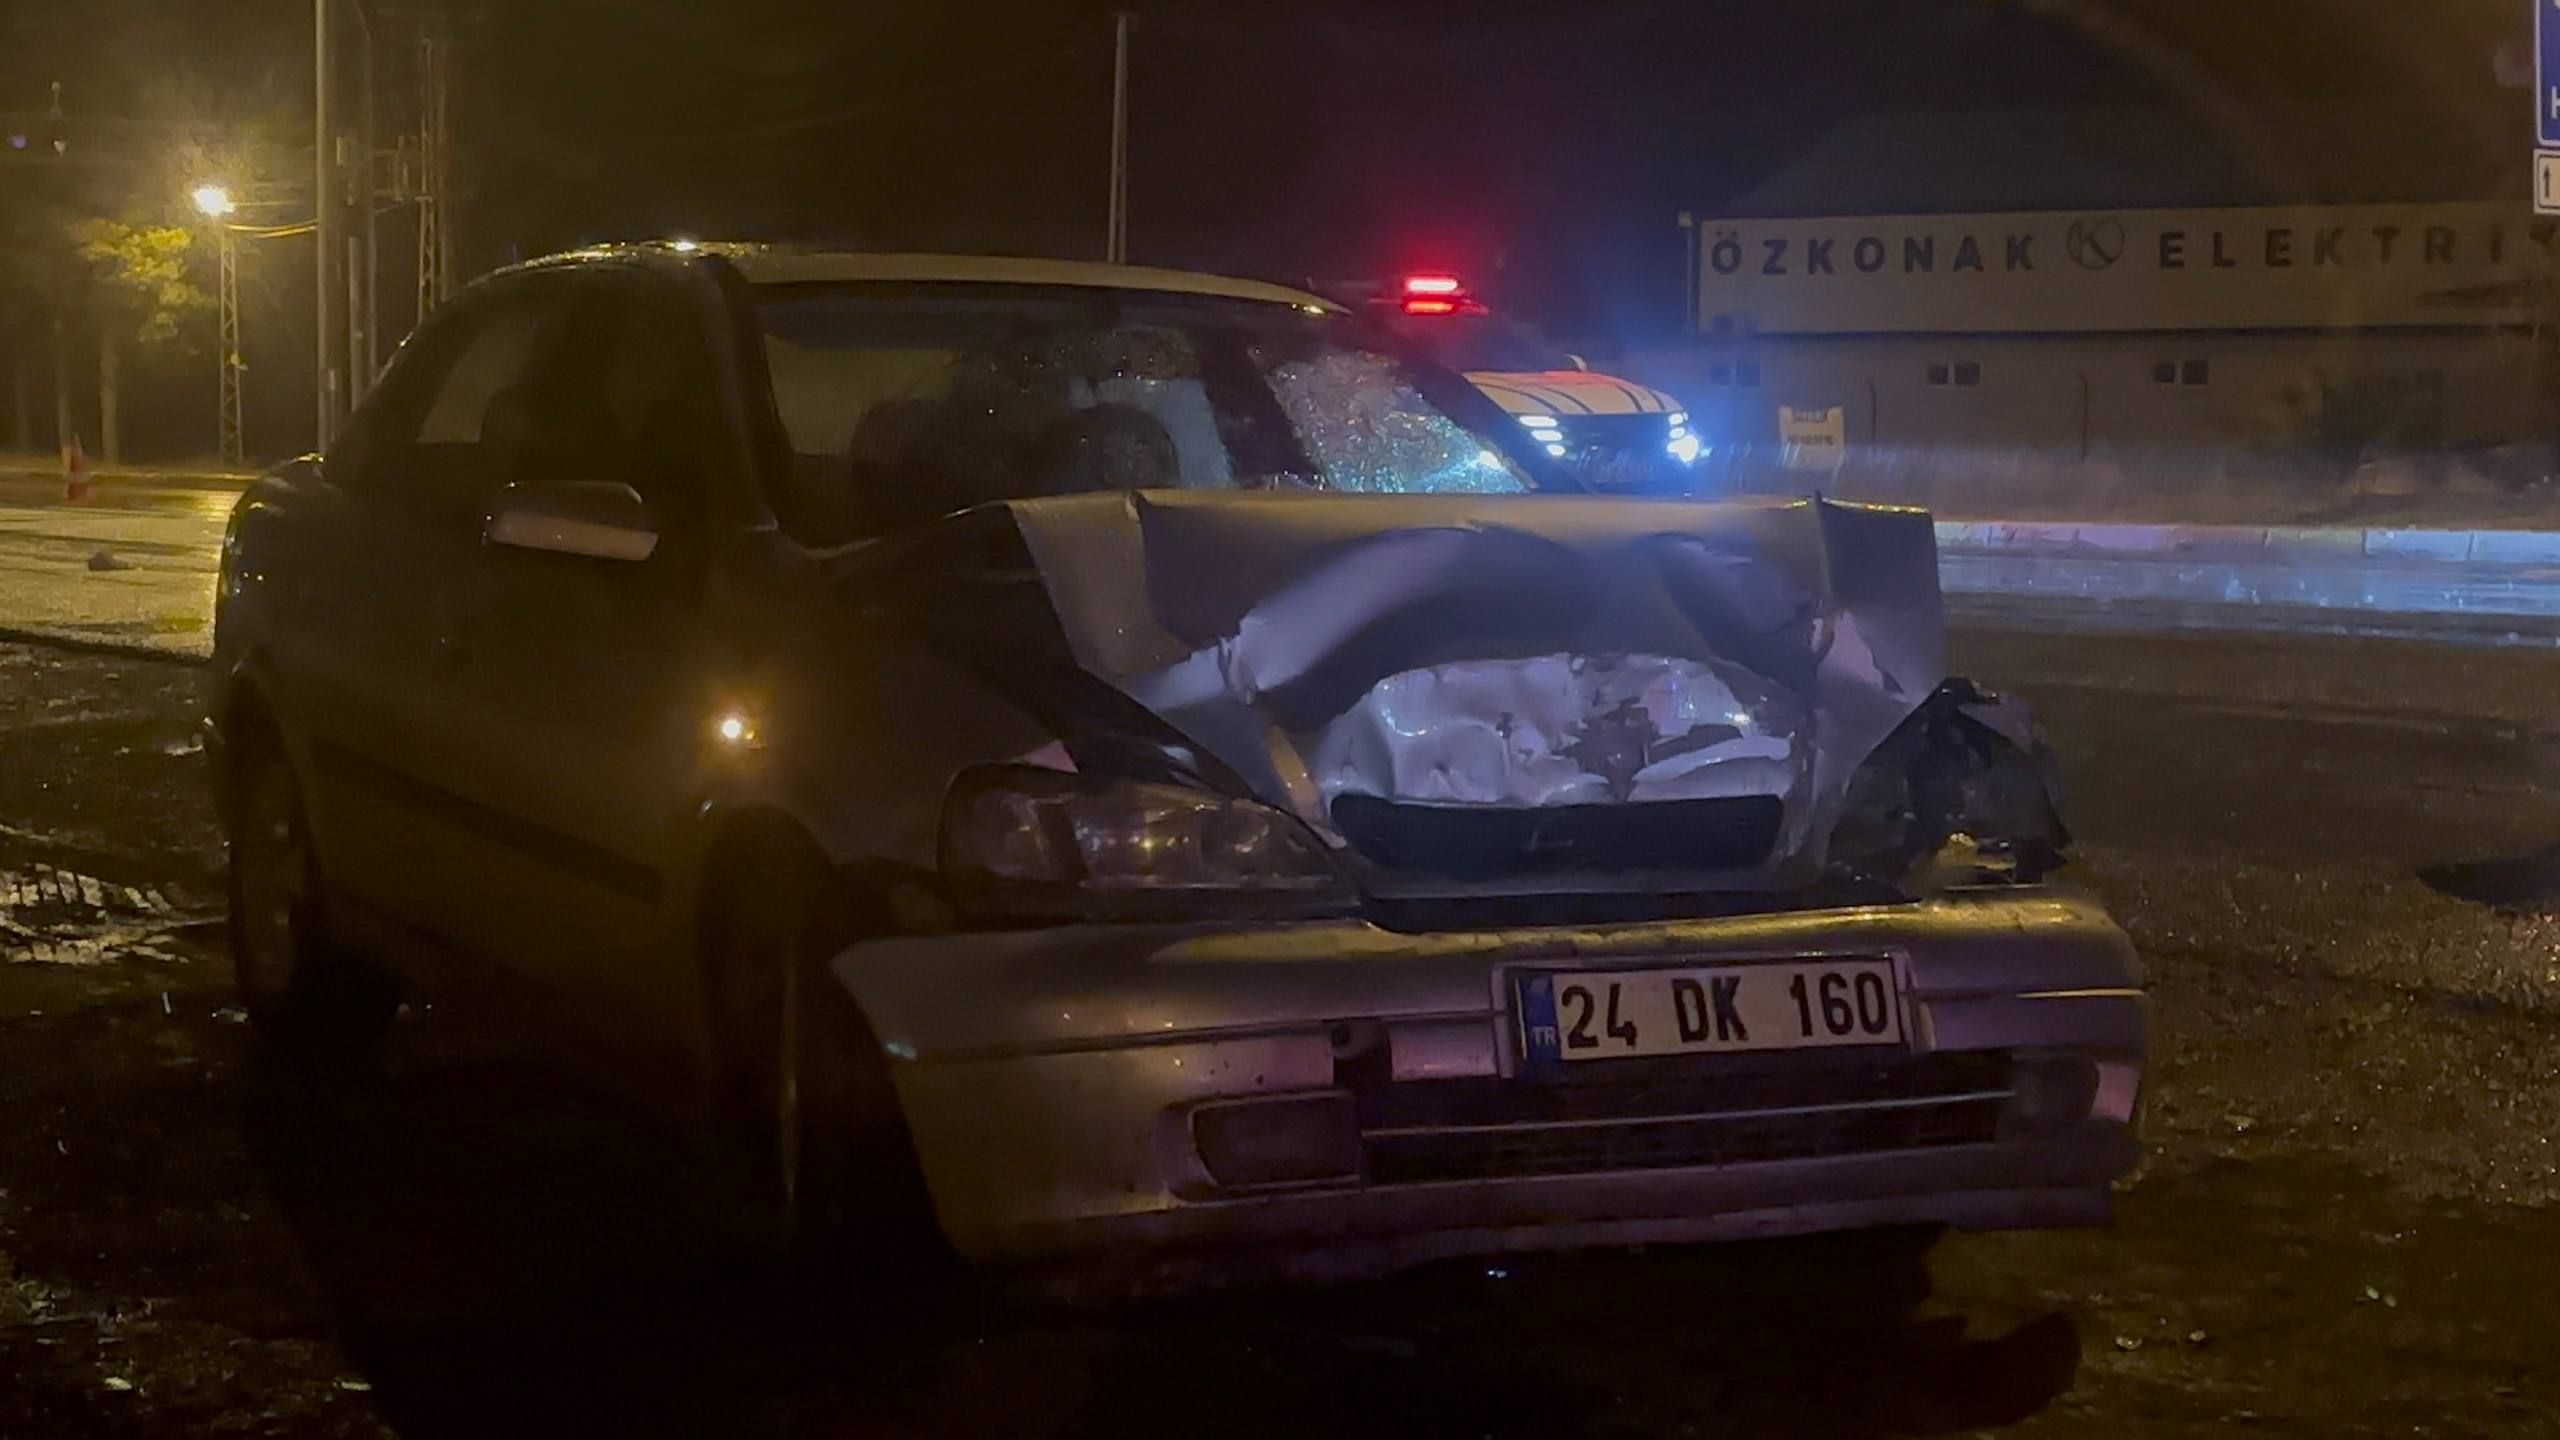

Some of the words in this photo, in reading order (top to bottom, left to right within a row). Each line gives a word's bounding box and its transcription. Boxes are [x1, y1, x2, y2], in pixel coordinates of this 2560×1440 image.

[1711, 230, 2035, 275] ÖZKONAK
[1532, 1026, 1557, 1046] TR
[1561, 983, 1638, 1049] 24
[1671, 975, 1749, 1044] DK
[1790, 971, 1888, 1038] 160
